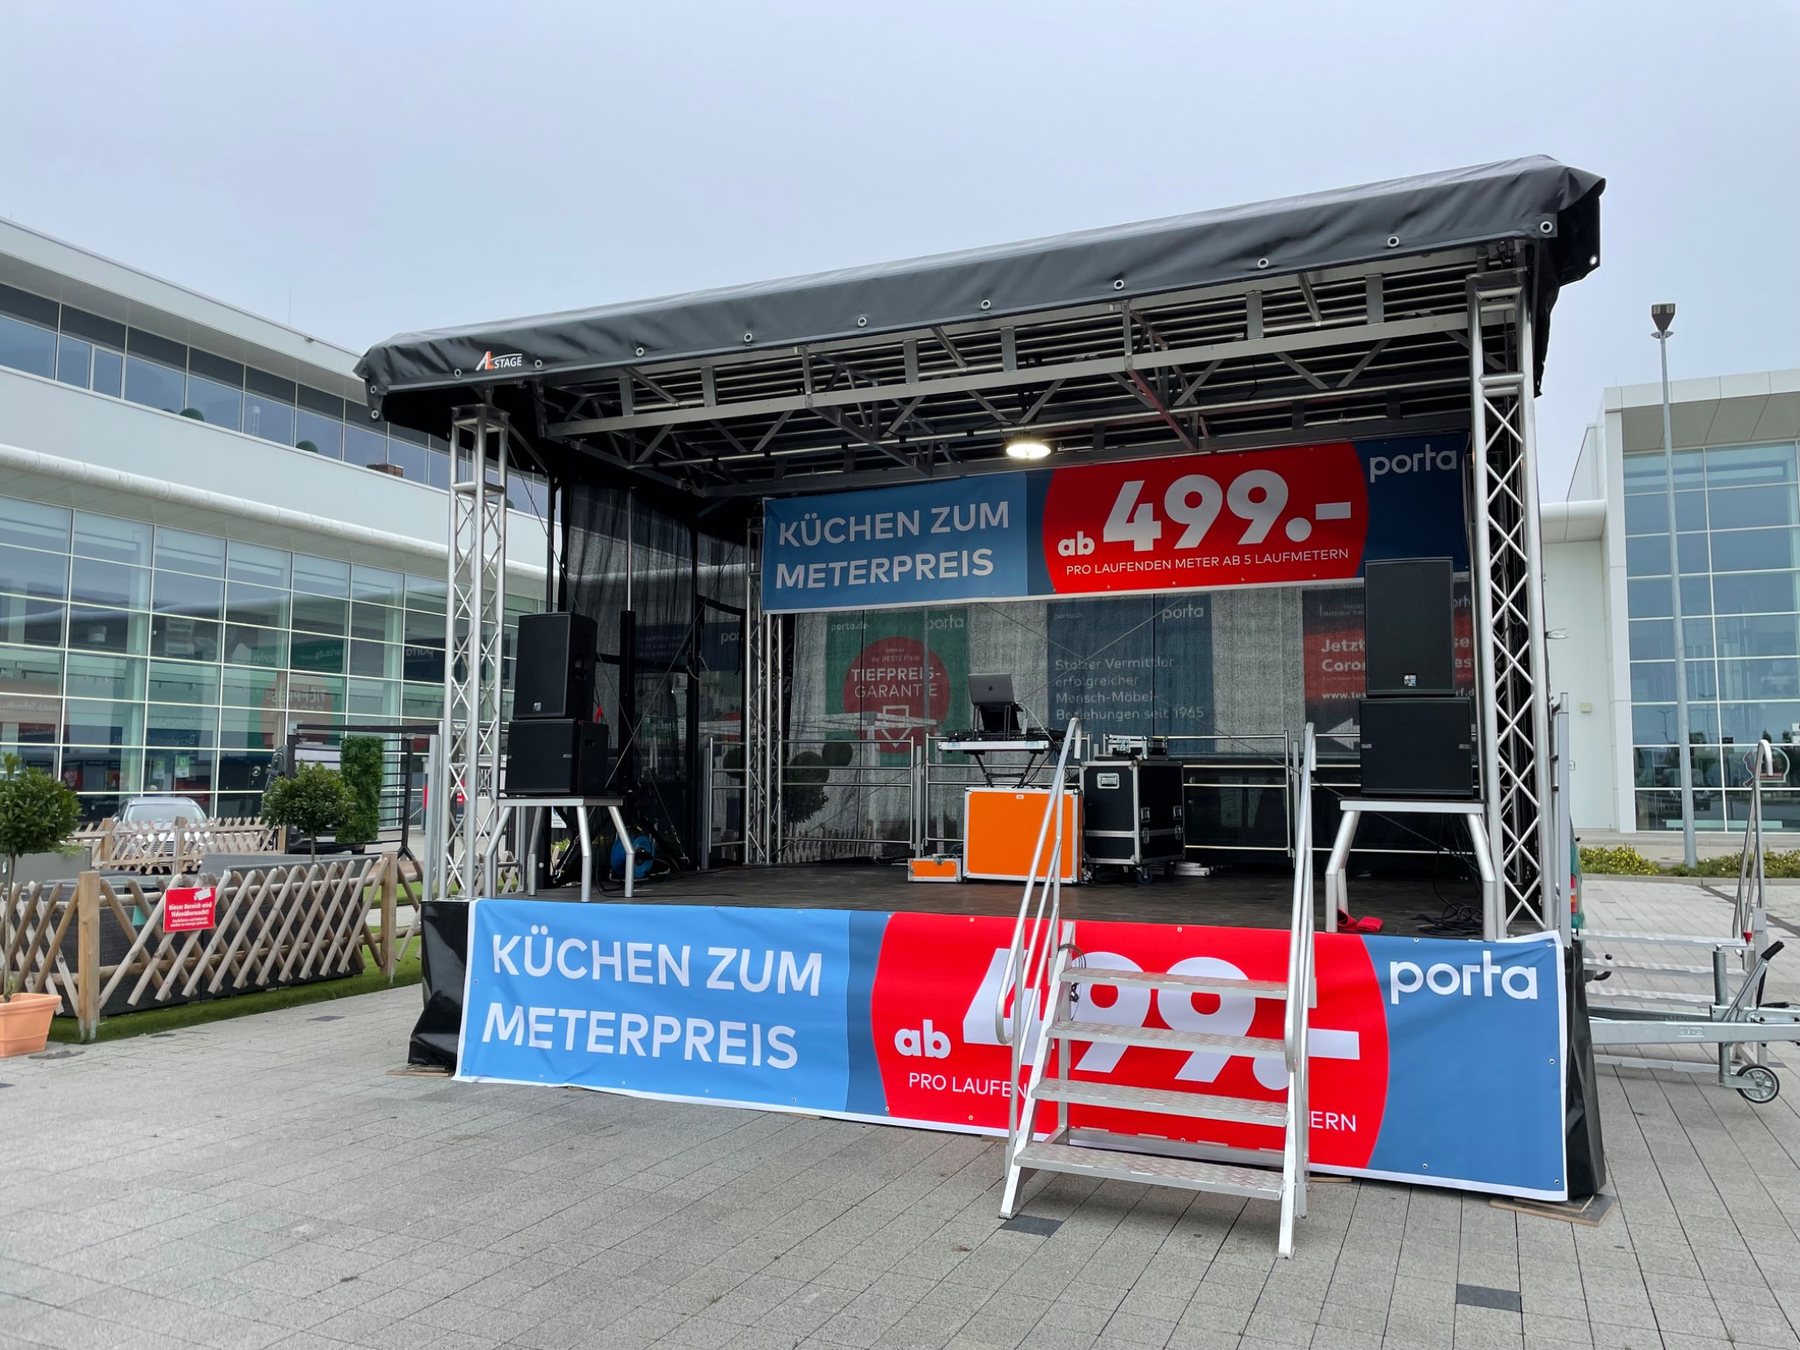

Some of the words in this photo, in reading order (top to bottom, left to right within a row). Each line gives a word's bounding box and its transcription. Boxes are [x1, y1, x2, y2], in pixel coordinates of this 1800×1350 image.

[494, 356, 522, 369] STAGE
[1369, 444, 1457, 484] porta
[779, 510, 920, 548] KÜCHEN
[930, 501, 1009, 534] ZUM
[1057, 531, 1095, 557] ab
[1103, 468, 1352, 552] 499.-
[775, 548, 994, 590] METERPREIS
[1066, 565, 1091, 576] PRO
[1095, 559, 1171, 574] LAUFENDEN
[1175, 556, 1219, 569] METER
[1222, 555, 1241, 566] AB
[1244, 554, 1252, 565] 5
[1255, 548, 1349, 564] LAUFMETERN
[1162, 603, 1204, 623] porta
[1055, 659, 1102, 671] Stolzer
[1106, 657, 1175, 669] Vermittler
[854, 683, 938, 698] GARANTE
[1056, 708, 1140, 721] Beziehungen
[1144, 707, 1169, 720] seit
[1175, 706, 1204, 718] 1965
[492, 924, 691, 988] KÜCHEN
[706, 947, 823, 997] ZUM
[1389, 950, 1538, 1005] porta
[482, 1002, 798, 1070] METERPREIS
[894, 1019, 951, 1060] ab
[909, 1072, 946, 1091] PRO
[952, 1076, 1028, 1100] LAUFEN
